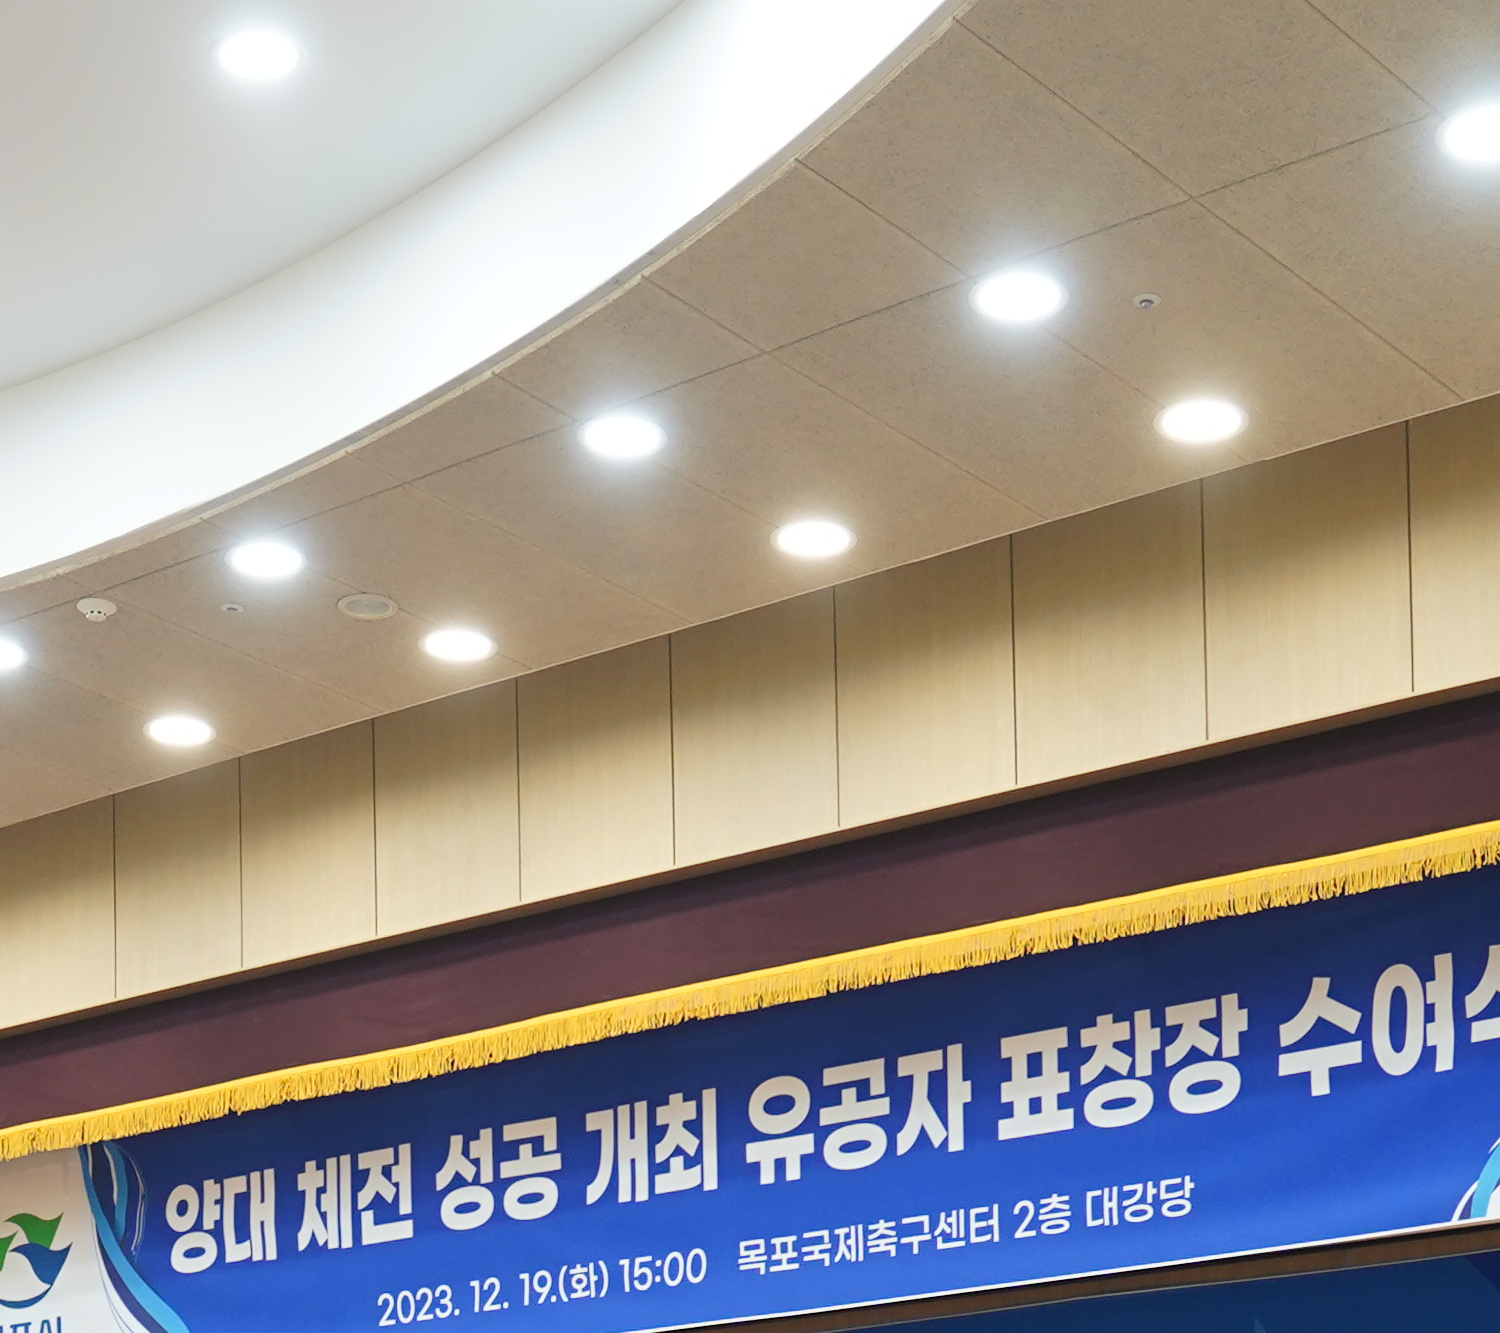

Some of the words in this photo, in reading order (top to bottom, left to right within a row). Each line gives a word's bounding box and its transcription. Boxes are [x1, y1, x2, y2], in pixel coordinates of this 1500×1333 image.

[166, 1169, 277, 1273] 양대
[298, 1144, 413, 1251] 체전
[436, 1117, 561, 1230] 성공
[586, 1088, 717, 1204] 개최
[746, 1044, 971, 1184] 유공자
[998, 994, 1247, 1140] 표창장
[378, 1286, 459, 1327] 2023.
[470, 1277, 508, 1312] 12.
[520, 1261, 608, 1306] 19.(화)
[619, 1248, 706, 1292] 15:00
[737, 1201, 1001, 1277] 목포국제축구센터
[1014, 1194, 1071, 1238] 2층
[1086, 1176, 1194, 1226] 대강당
